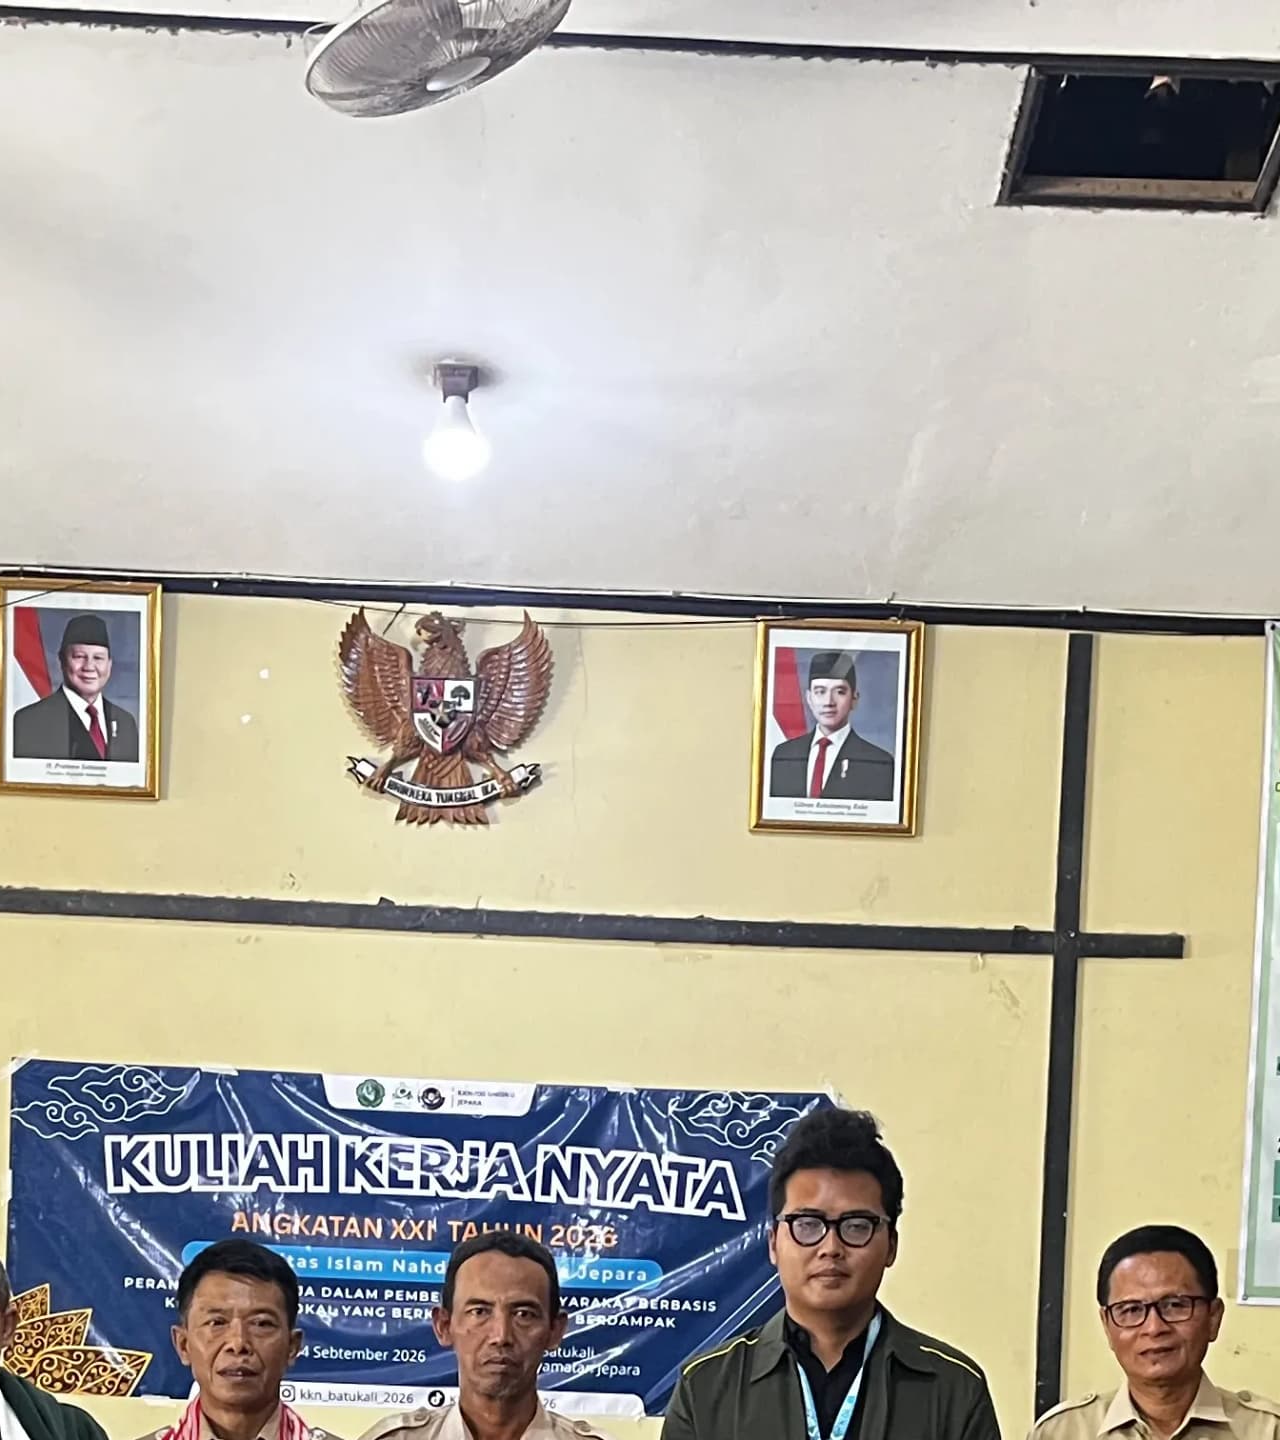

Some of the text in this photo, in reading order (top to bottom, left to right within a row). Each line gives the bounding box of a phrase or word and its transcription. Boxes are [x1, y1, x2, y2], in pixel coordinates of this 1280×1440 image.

[104, 1133, 746, 1221] KULIAH KERJA NYATA
[232, 1211, 382, 1239] ANGKATAN
[551, 1225, 618, 1247] 2026
[328, 1256, 383, 1272] Islam
[577, 1267, 647, 1284] Jepara
[322, 1287, 377, 1300] DALAM
[638, 1298, 717, 1312] BERBASIS
[342, 1306, 385, 1318] YANG
[575, 1315, 677, 1329] BERDAMPAK
[313, 1346, 426, 1363] Sebtember 2026
[300, 1389, 414, 1405] kkn_batukali_2026
